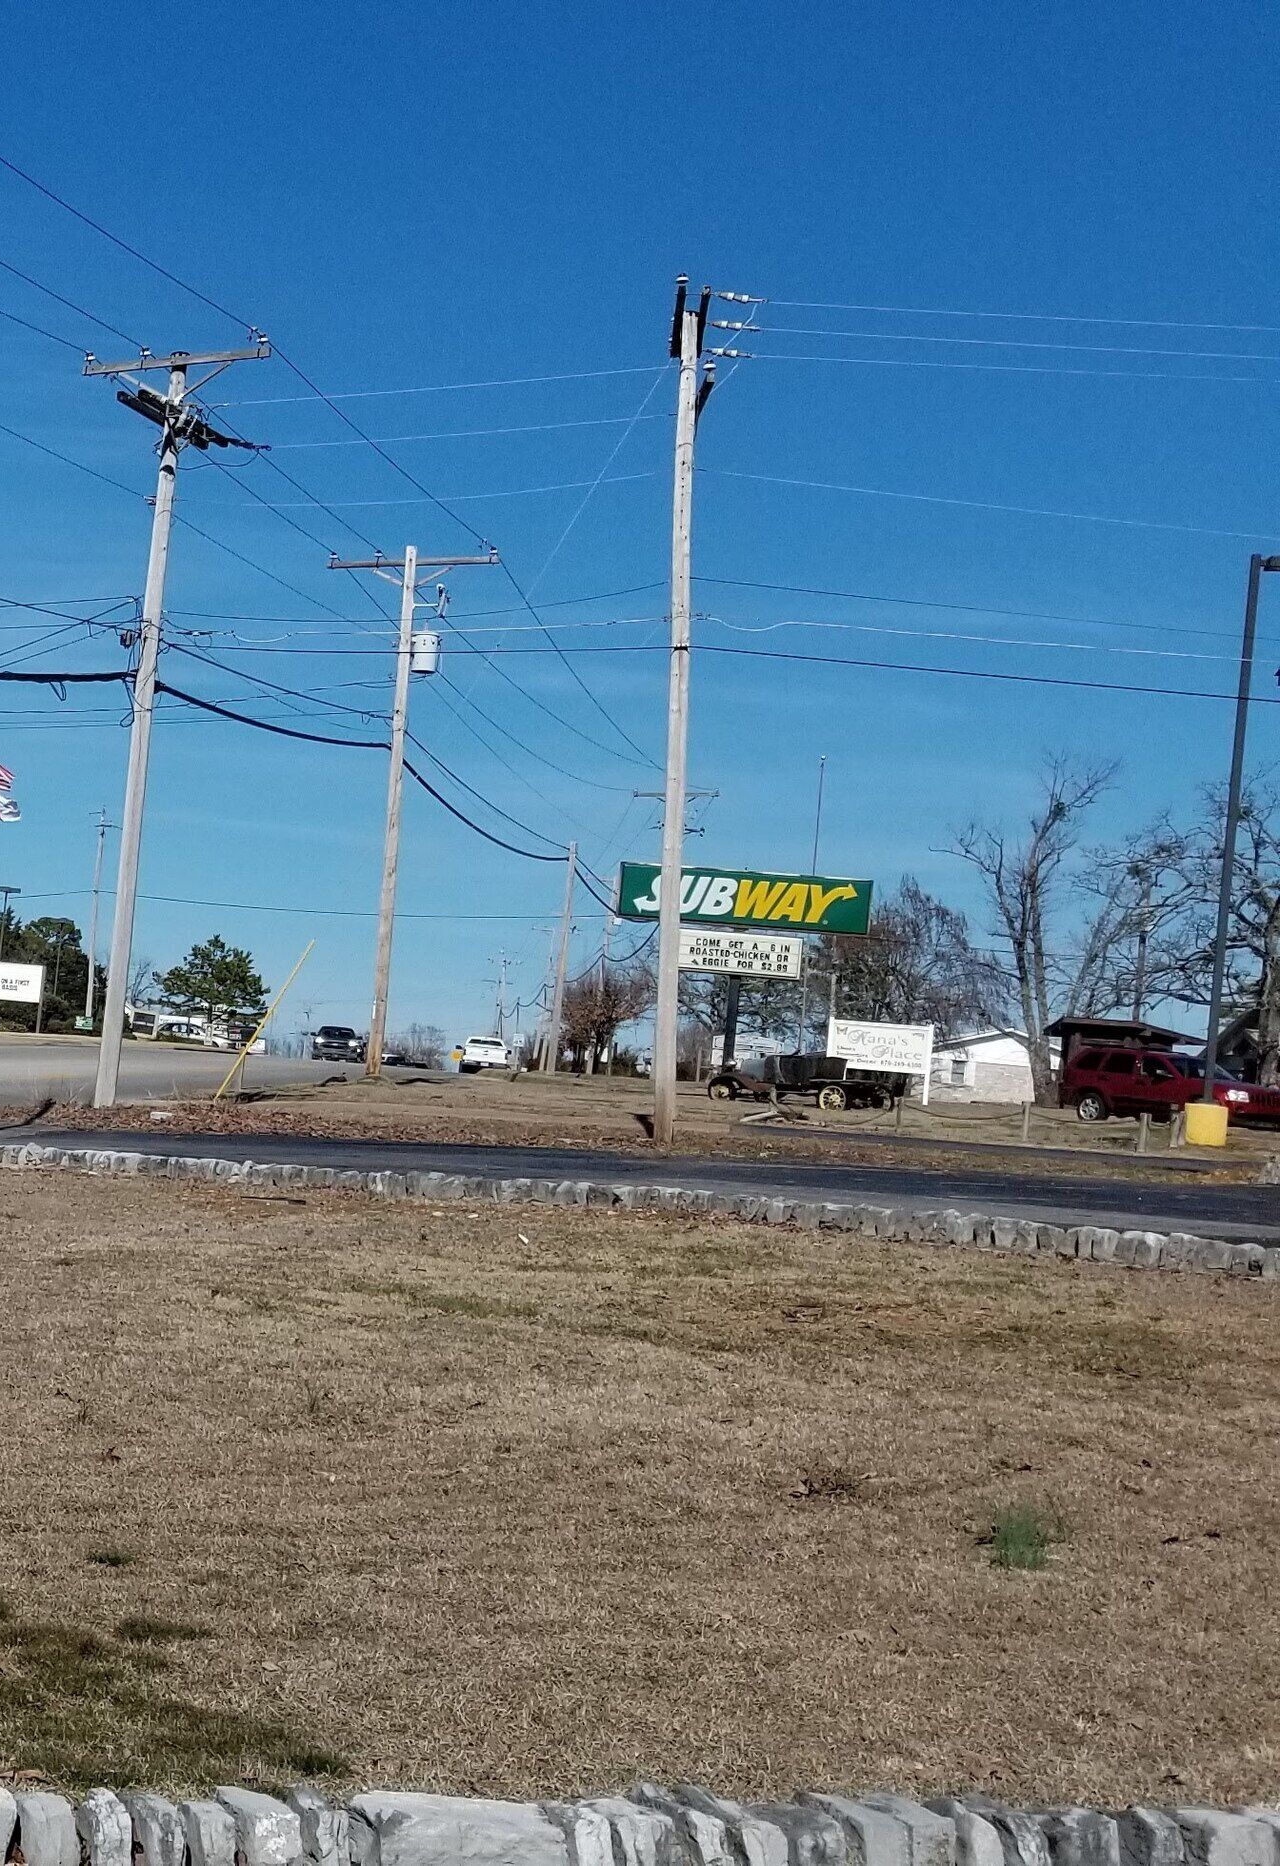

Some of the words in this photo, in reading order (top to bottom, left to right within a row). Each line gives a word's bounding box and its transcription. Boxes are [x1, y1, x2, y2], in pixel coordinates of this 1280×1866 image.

[633, 875, 858, 924] SUBWAY
[696, 938, 721, 947] COME
[729, 940, 744, 949] GET
[752, 942, 758, 951] A
[781, 945, 790, 953] IN
[737, 959, 753, 969] FOR
[777, 954, 789, 962] OR
